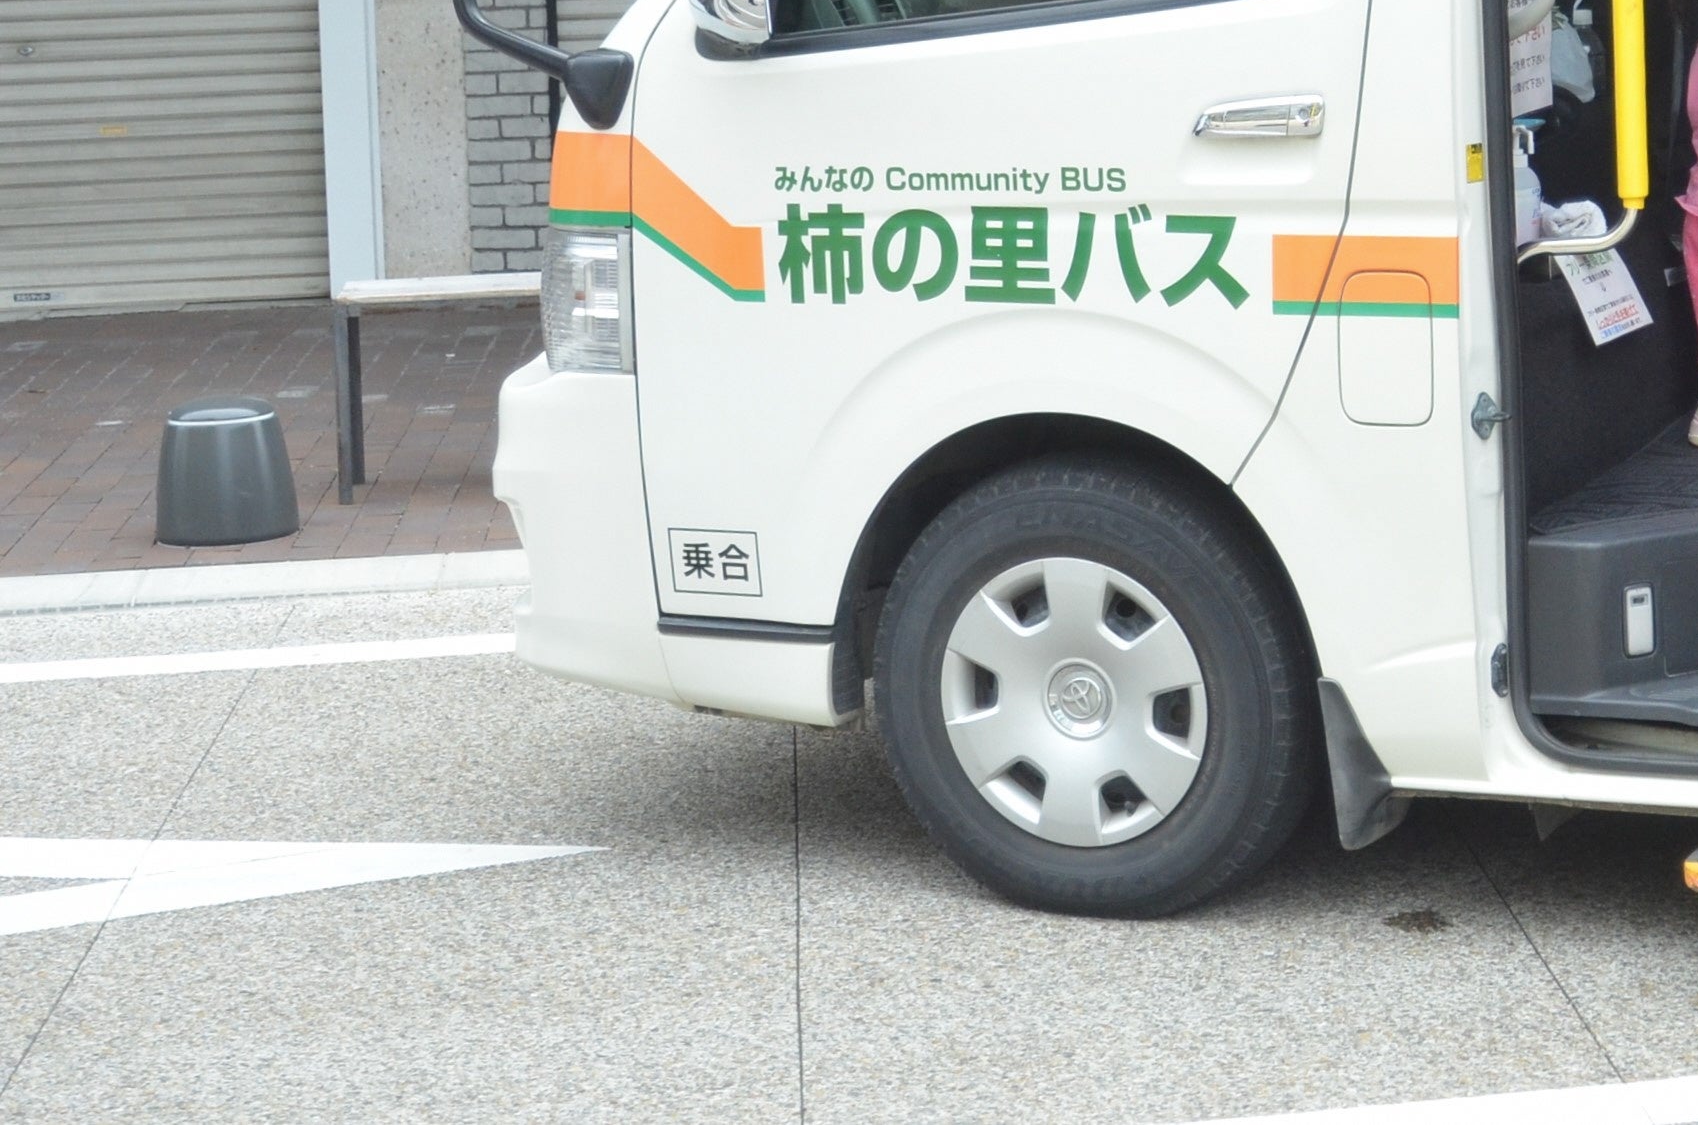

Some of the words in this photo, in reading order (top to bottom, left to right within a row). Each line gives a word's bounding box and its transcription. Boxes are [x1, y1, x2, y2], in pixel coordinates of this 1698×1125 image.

[774, 165, 874, 193] みんなの
[885, 166, 1050, 195] Community
[1060, 166, 1127, 193] BUS
[777, 203, 1251, 310] 柿の里バス
[682, 542, 750, 582] 乗合
